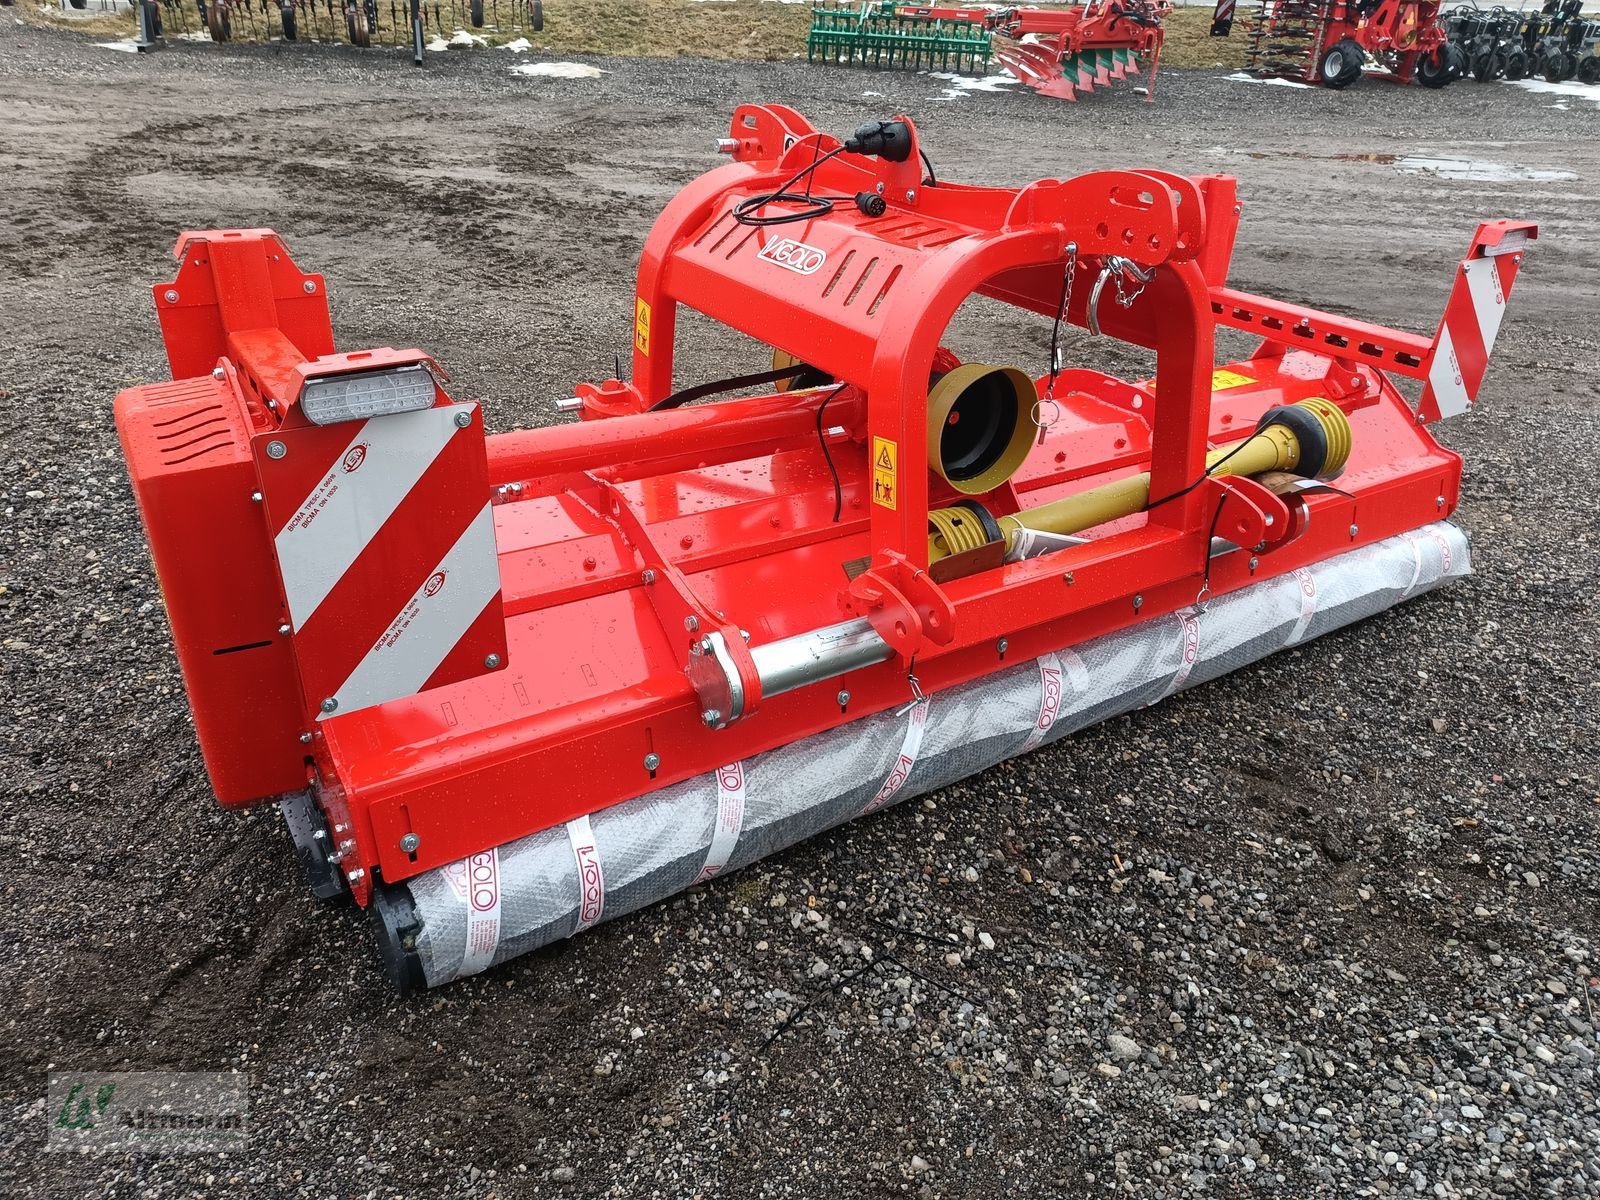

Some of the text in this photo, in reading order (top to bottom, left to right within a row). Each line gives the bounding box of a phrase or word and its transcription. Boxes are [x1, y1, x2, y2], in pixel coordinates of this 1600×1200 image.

[757, 234, 827, 275] VIGOLO
[287, 511, 306, 532] BICMA
[301, 508, 320, 529] BICMA
[319, 498, 328, 508] DIN
[374, 633, 391, 652] BICMA
[386, 629, 403, 648] BICMA
[1040, 668, 1060, 729] VIGOLO
[470, 850, 496, 909] GOLO
